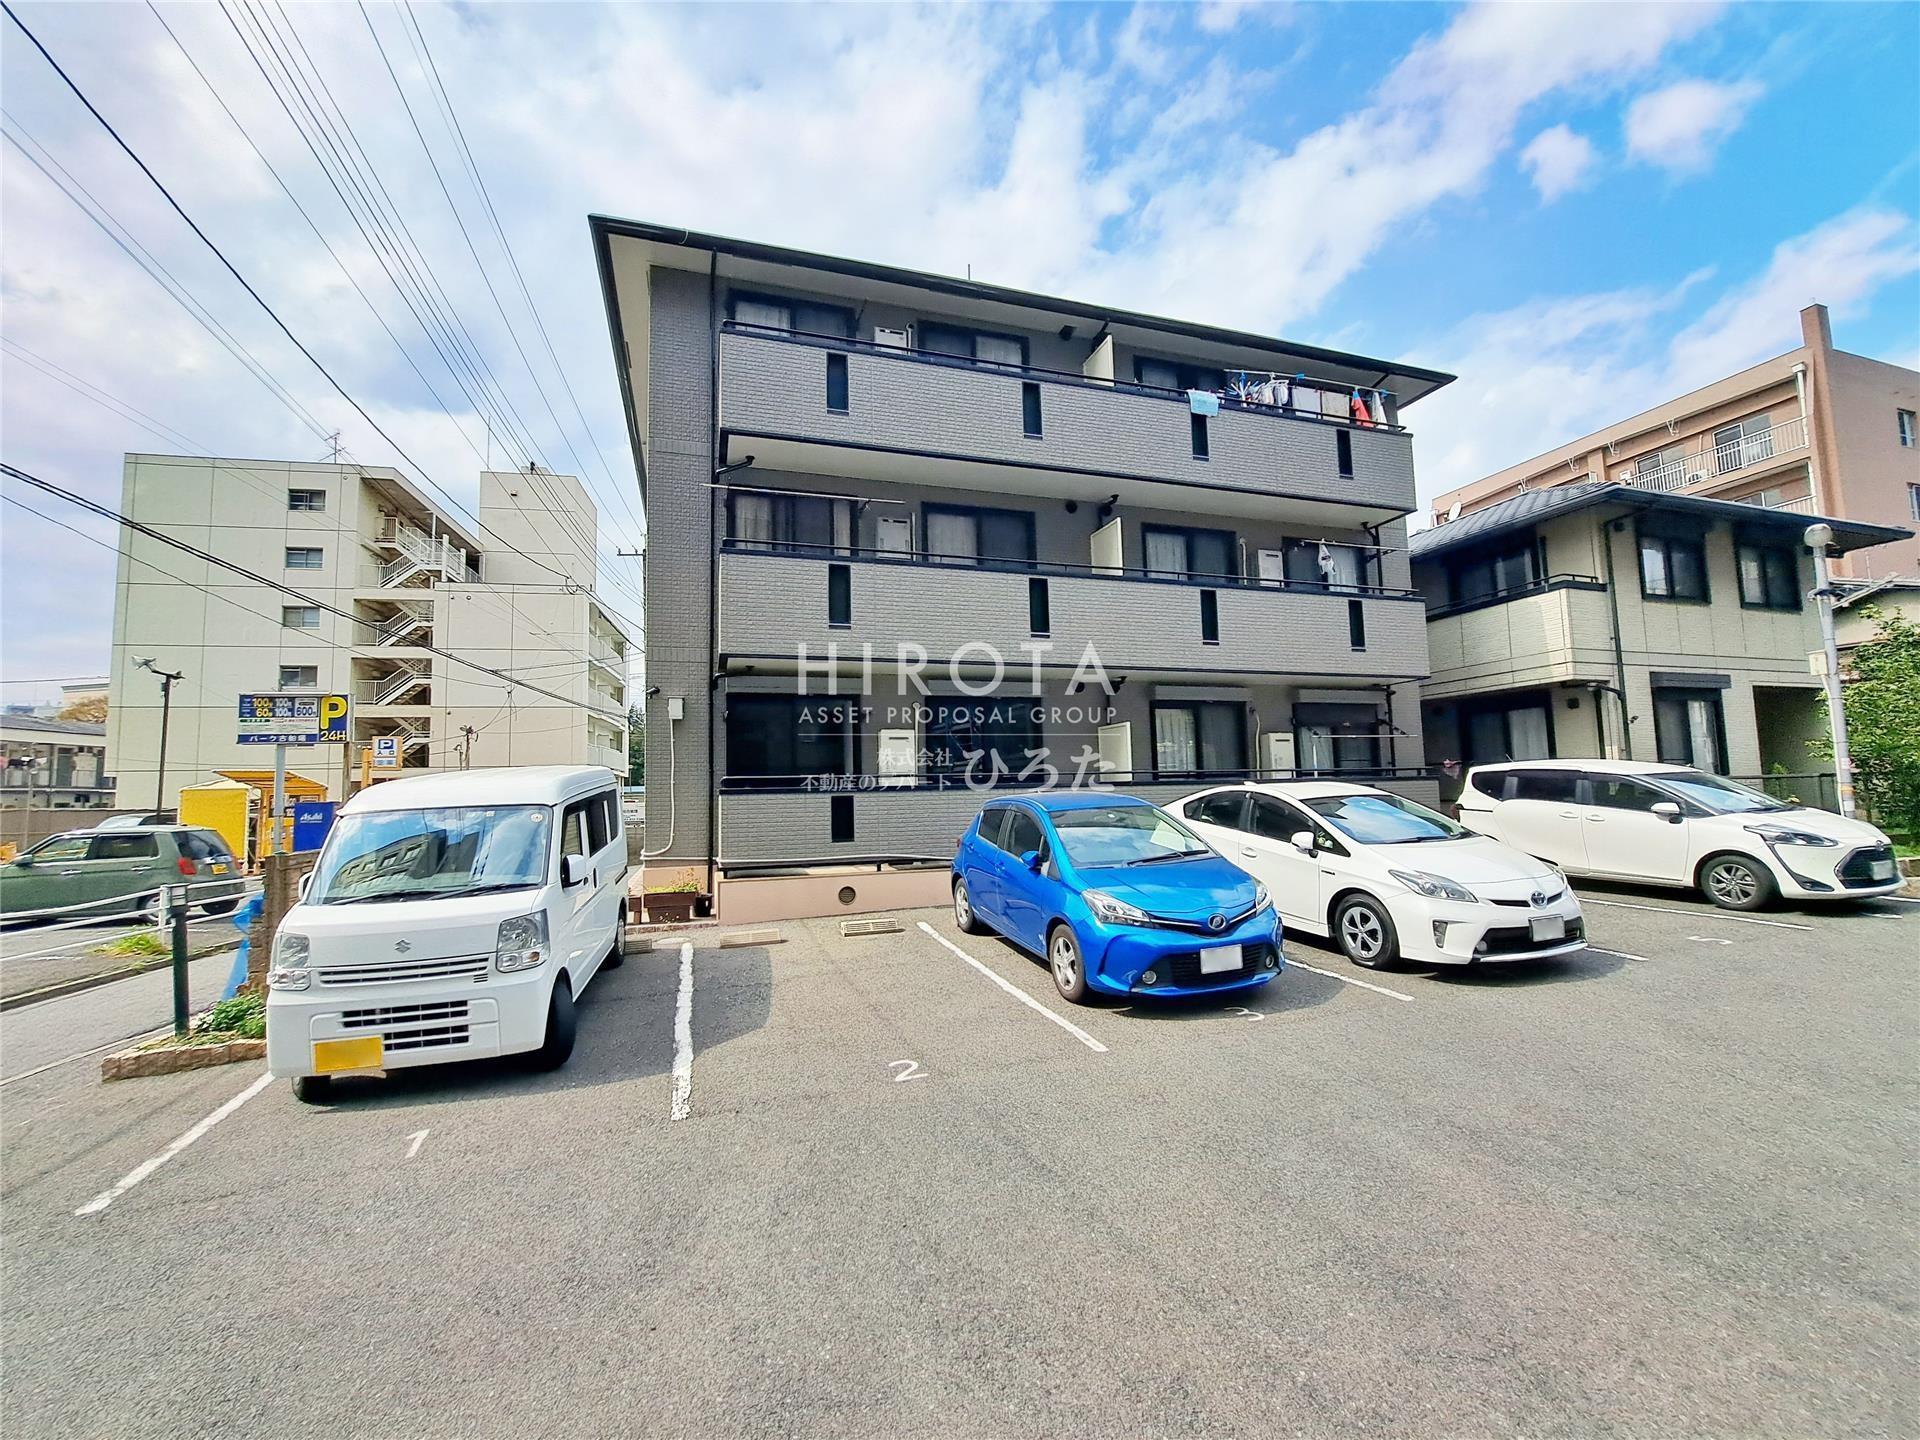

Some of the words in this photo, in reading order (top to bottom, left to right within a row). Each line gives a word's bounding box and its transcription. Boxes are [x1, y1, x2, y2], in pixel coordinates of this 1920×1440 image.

[321, 696, 347, 729] P
[320, 730, 346, 741] 24H
[379, 740, 393, 749] P
[1223, 1006, 1265, 1021] 3
[888, 1060, 929, 1081] 2
[404, 1128, 431, 1159] 1
